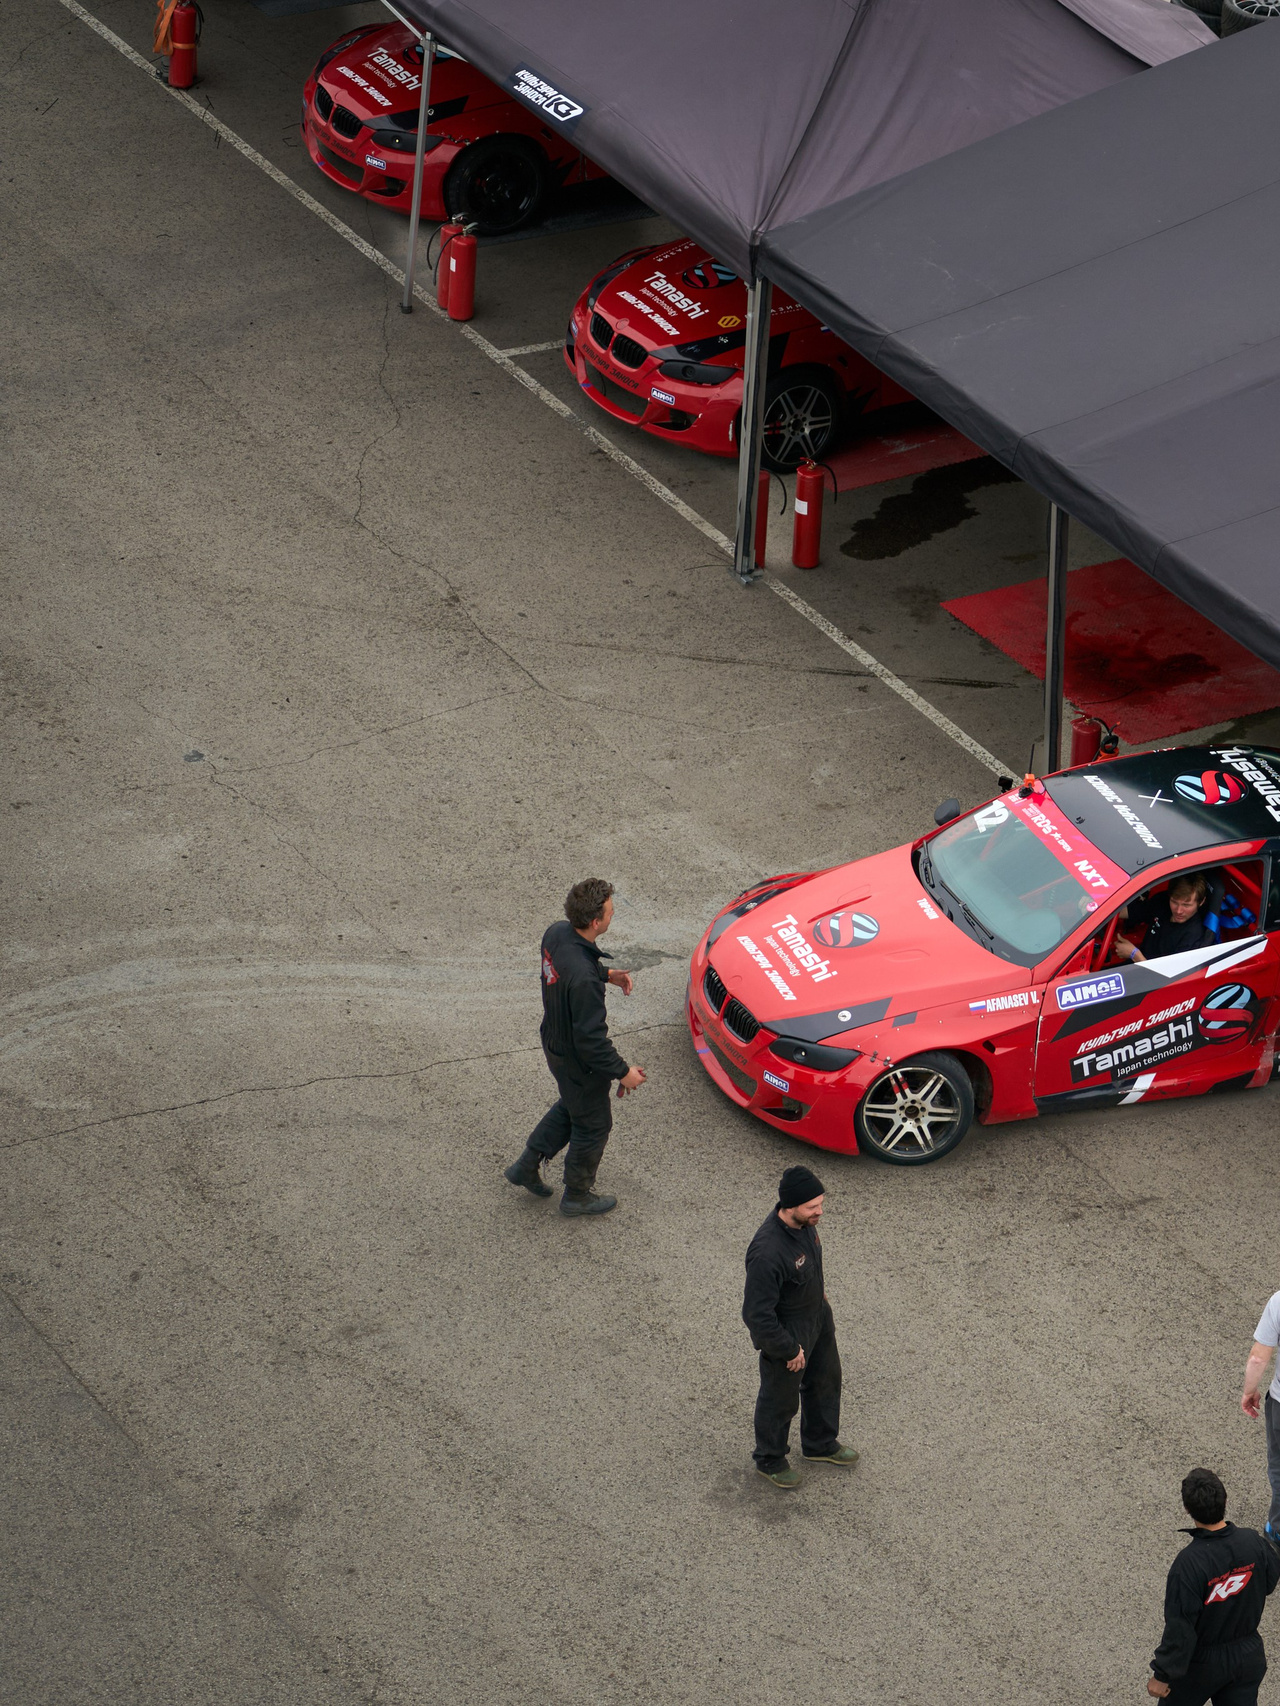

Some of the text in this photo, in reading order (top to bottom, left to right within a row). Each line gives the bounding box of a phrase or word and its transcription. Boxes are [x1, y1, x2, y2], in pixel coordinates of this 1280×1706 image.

[513, 81, 547, 105] ЗАНОСА
[515, 69, 559, 97] КУЛЬТУРА
[644, 271, 709, 320] Tamashi
[609, 367, 639, 389] ЗАНОСА
[652, 389, 674, 404] AIMOL
[974, 799, 1009, 833] 12
[1030, 813, 1058, 834] RDS
[1083, 775, 1163, 849] КУЛЬТУРА ЗАНОСА
[1073, 860, 1109, 888] NXT
[771, 914, 838, 983] Tamashi
[775, 947, 801, 976] technology
[736, 935, 797, 1000] КУЛЬТУРА ЗАНОСА
[986, 991, 1040, 1012] AFANASEV V.
[1060, 977, 1121, 1005] AIMOL
[1076, 996, 1196, 1054] КУЛЬТУРА ЗАНОСА
[1073, 1015, 1193, 1077] Tamashi
[1143, 1040, 1193, 1068] technology
[764, 1072, 788, 1092] AIMOL
